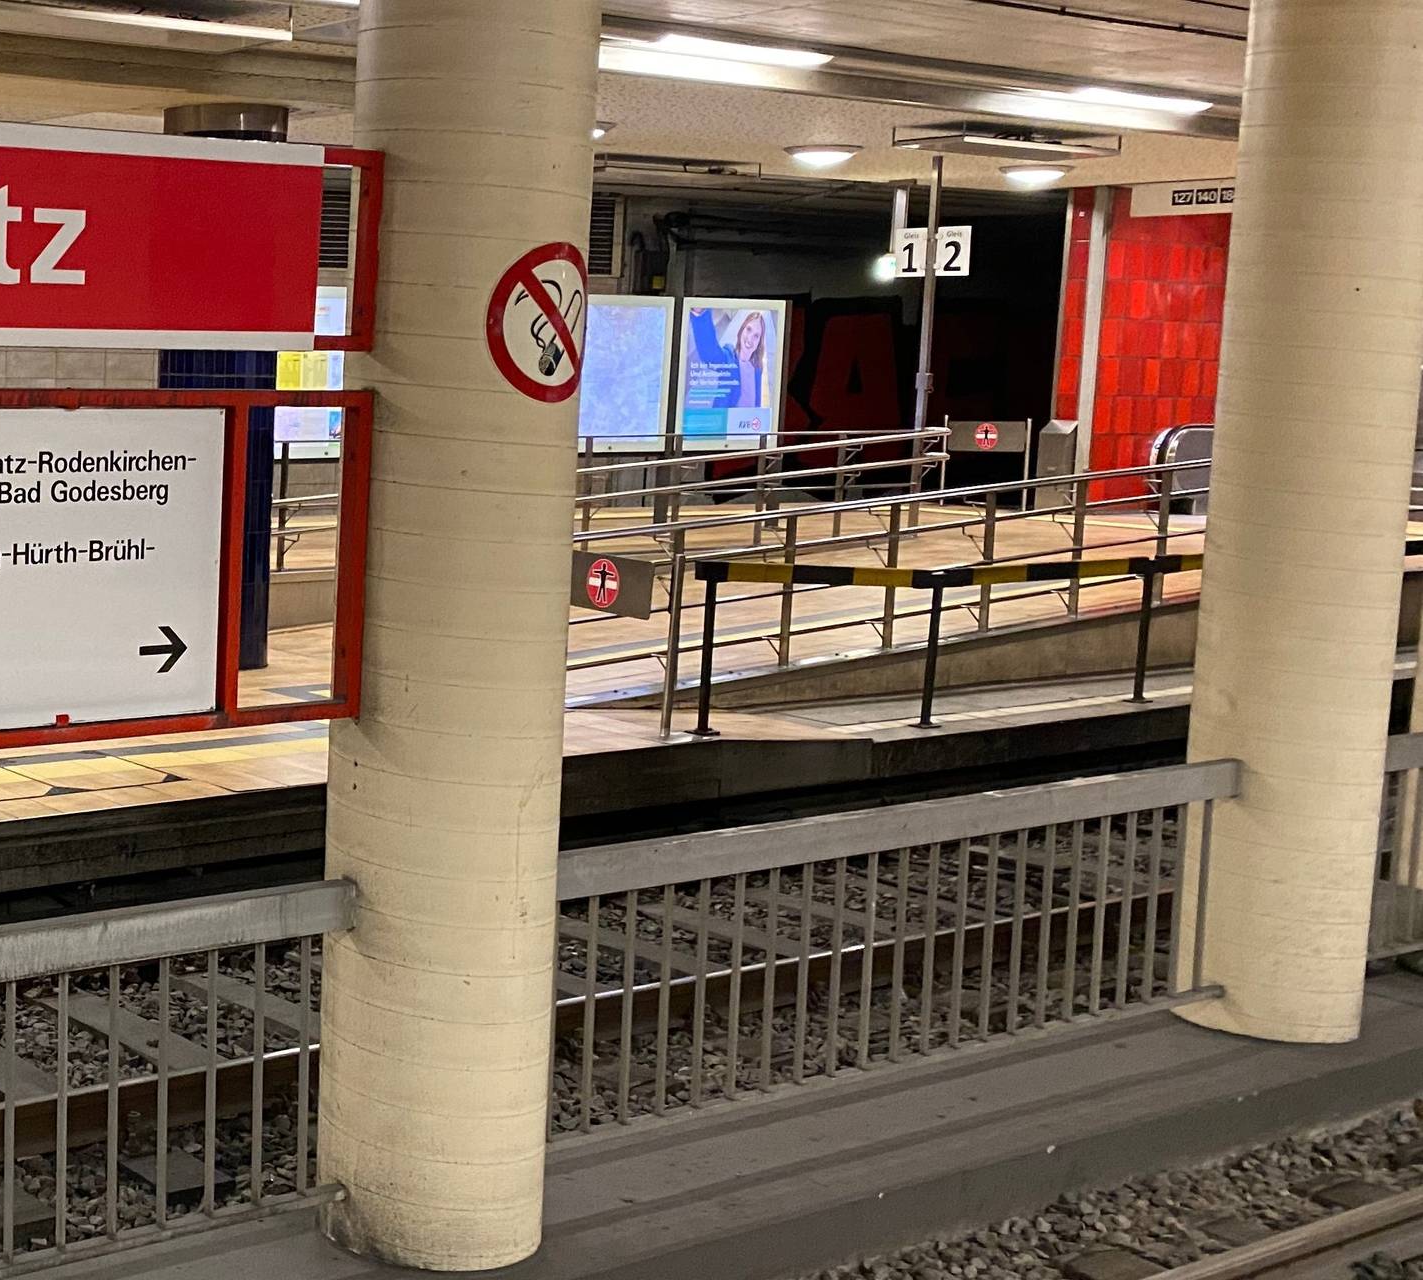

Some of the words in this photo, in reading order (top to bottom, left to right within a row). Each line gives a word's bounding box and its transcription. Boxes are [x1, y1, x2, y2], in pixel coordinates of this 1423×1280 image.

[1173, 192, 1193, 203] 127
[1197, 191, 1217, 202] 140
[1221, 189, 1234, 201] 18
[946, 230, 963, 238] Gleis
[902, 242, 917, 272] 1
[943, 240, 961, 271] 2
[51, 479, 169, 505] Godesberg
